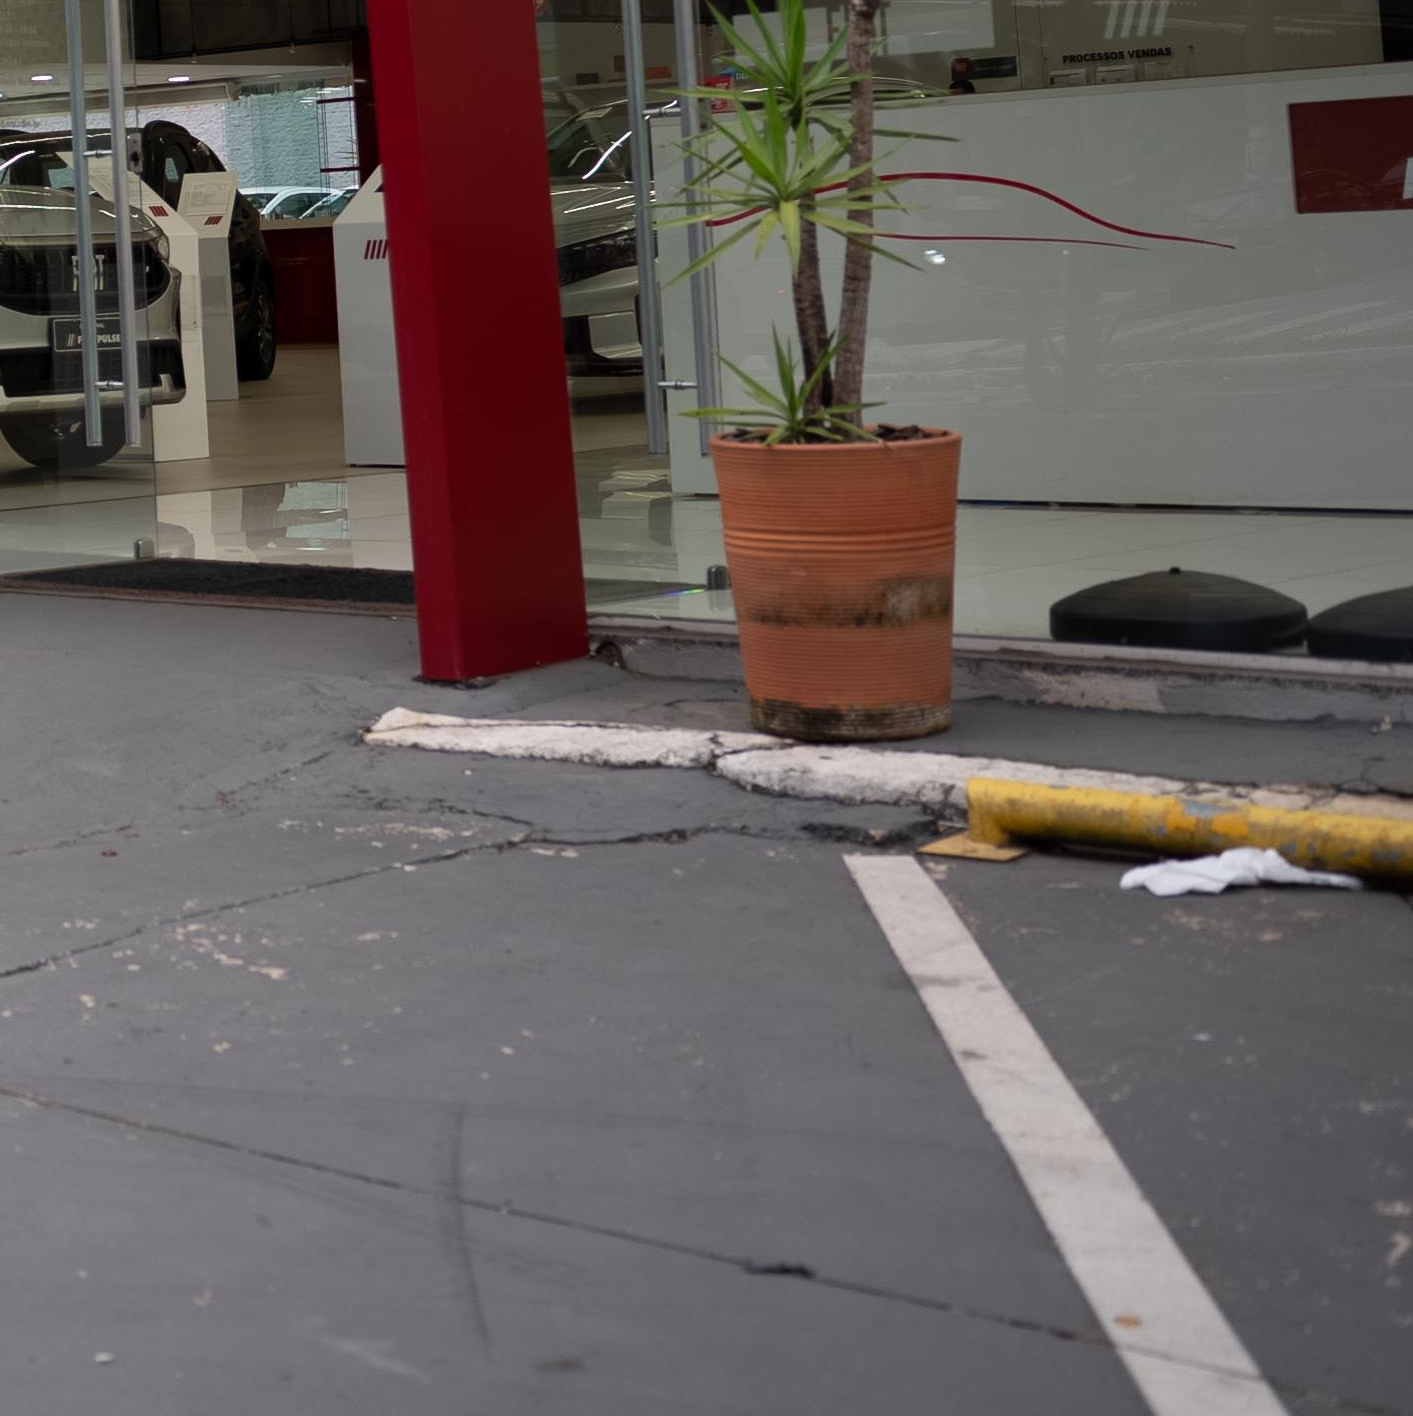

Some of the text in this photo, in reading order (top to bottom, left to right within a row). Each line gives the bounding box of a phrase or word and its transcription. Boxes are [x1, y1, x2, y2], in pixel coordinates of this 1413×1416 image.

[1062, 46, 1172, 65] PROCESSOS VENDAS
[97, 334, 121, 343] PULSE
